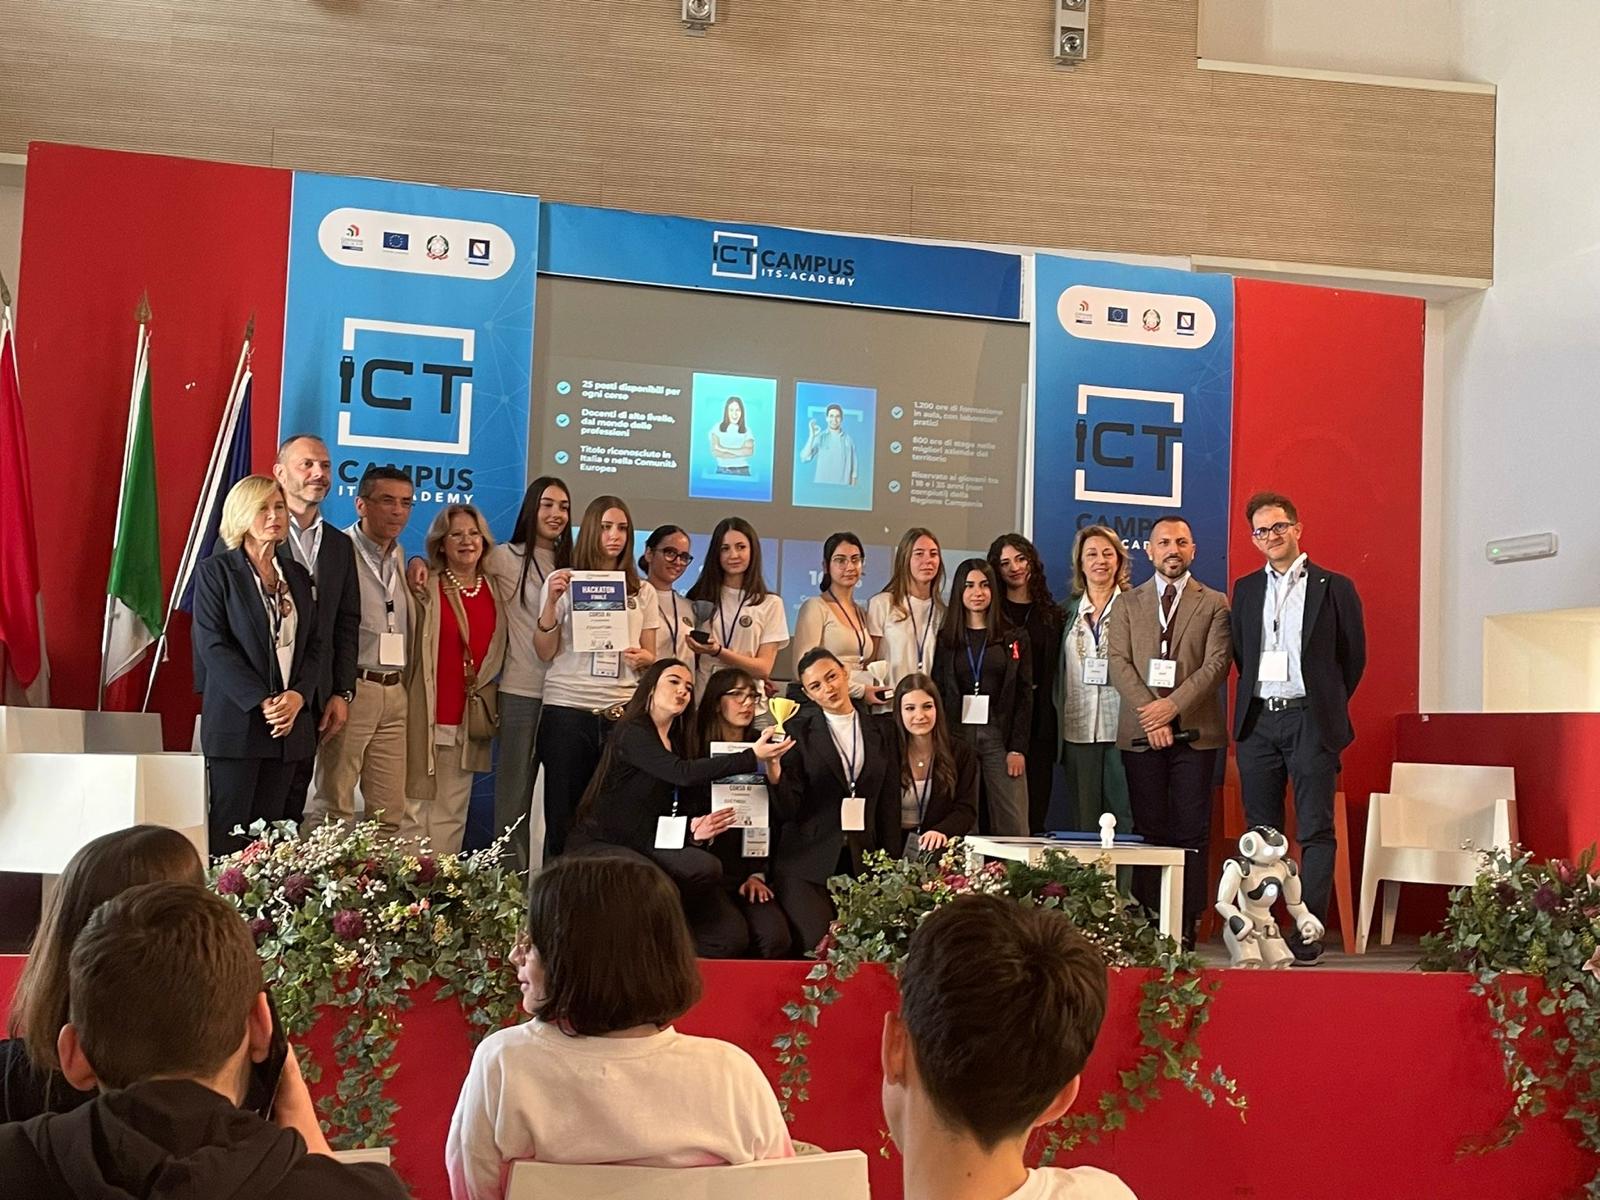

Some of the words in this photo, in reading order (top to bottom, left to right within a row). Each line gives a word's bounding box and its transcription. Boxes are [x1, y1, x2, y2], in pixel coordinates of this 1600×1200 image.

[761, 250, 855, 276] CAMPUS
[761, 268, 855, 287] ITS-ACADEMY
[582, 380, 593, 389] 25
[594, 382, 617, 390] posti
[619, 383, 664, 395] disponibili
[665, 388, 680, 396] per
[582, 390, 603, 399] ogni
[604, 392, 629, 400] corso
[581, 408, 617, 418] Docenti
[618, 410, 627, 418] di
[628, 412, 646, 420] alto
[647, 413, 675, 424] livello,
[597, 419, 629, 428] mondo
[581, 427, 630, 437] professioni
[580, 445, 606, 454] Titolo
[607, 446, 661, 458] riconosciuto
[662, 450, 671, 459] in
[580, 455, 602, 463] Italia
[611, 457, 633, 465] nella
[634, 458, 677, 468] Comunità
[580, 464, 617, 473] Europea
[338, 460, 473, 491] CPUS
[1076, 513, 1154, 538] CAMP
